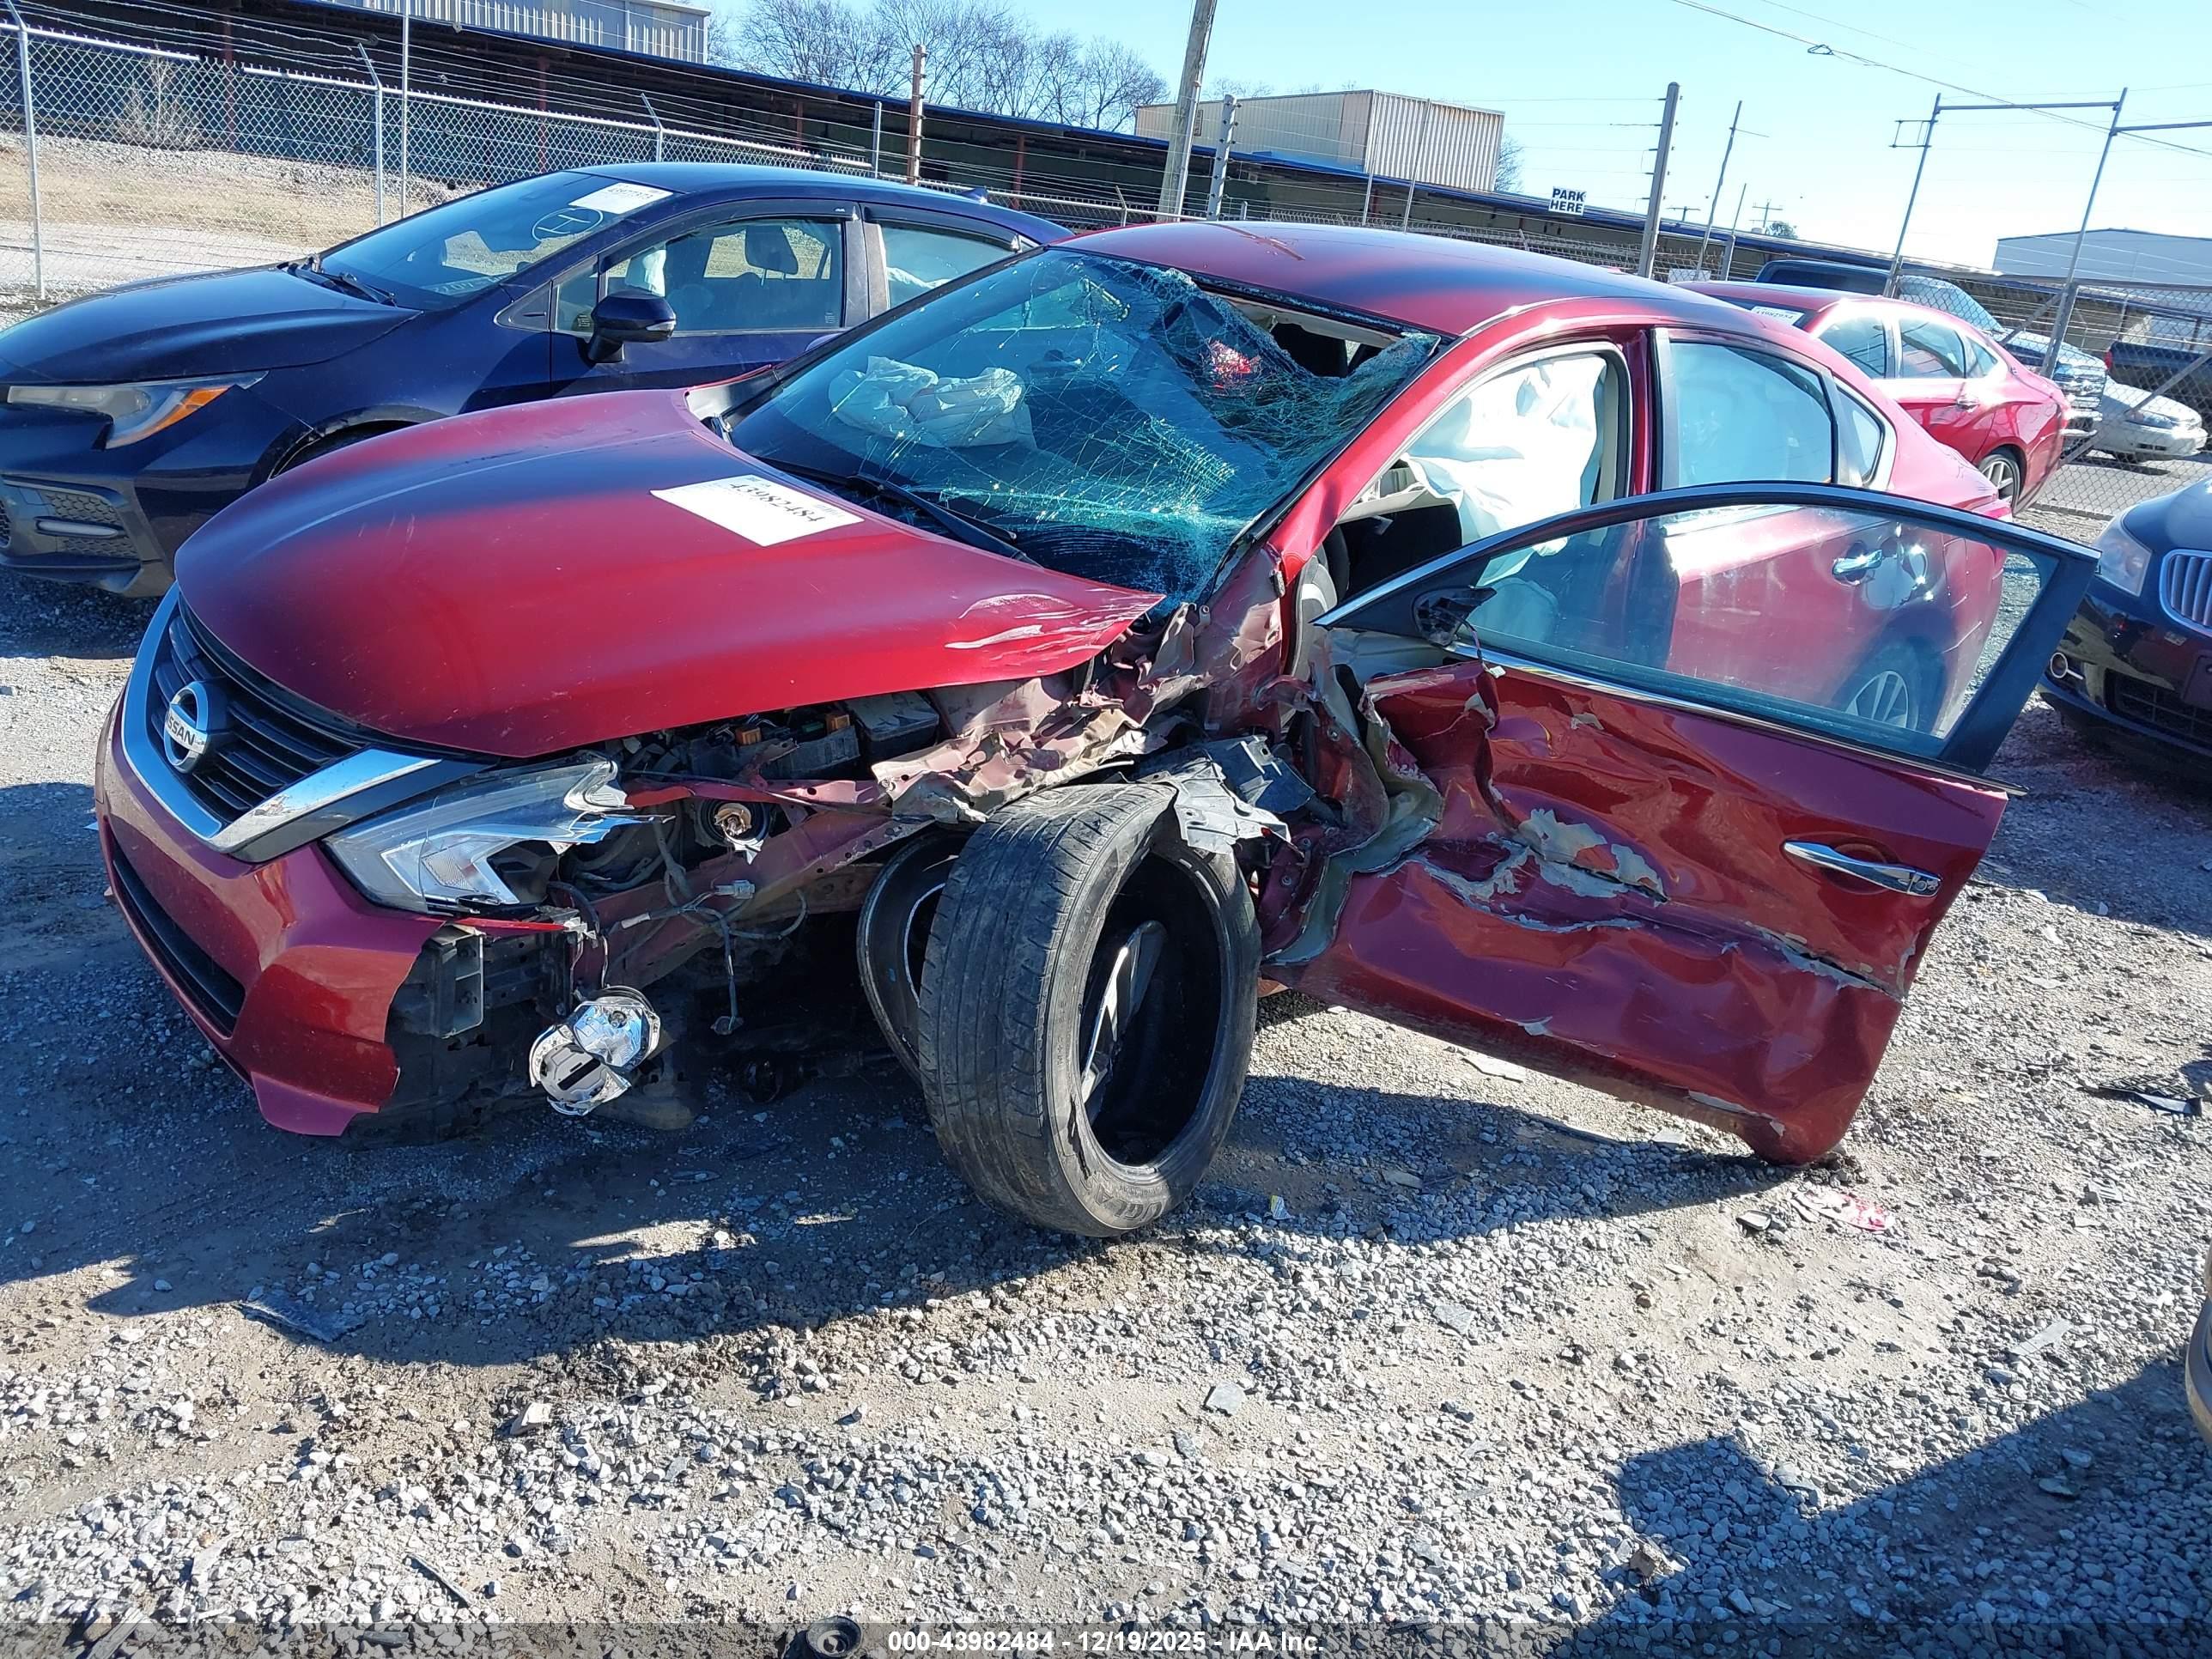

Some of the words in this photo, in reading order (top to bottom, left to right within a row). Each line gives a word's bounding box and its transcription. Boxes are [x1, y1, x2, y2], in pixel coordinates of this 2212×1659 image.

[1550, 199, 1583, 214] HERE
[1553, 188, 1585, 202] PARK
[730, 483, 825, 522] 43982484
[165, 712, 195, 746] SSAN
